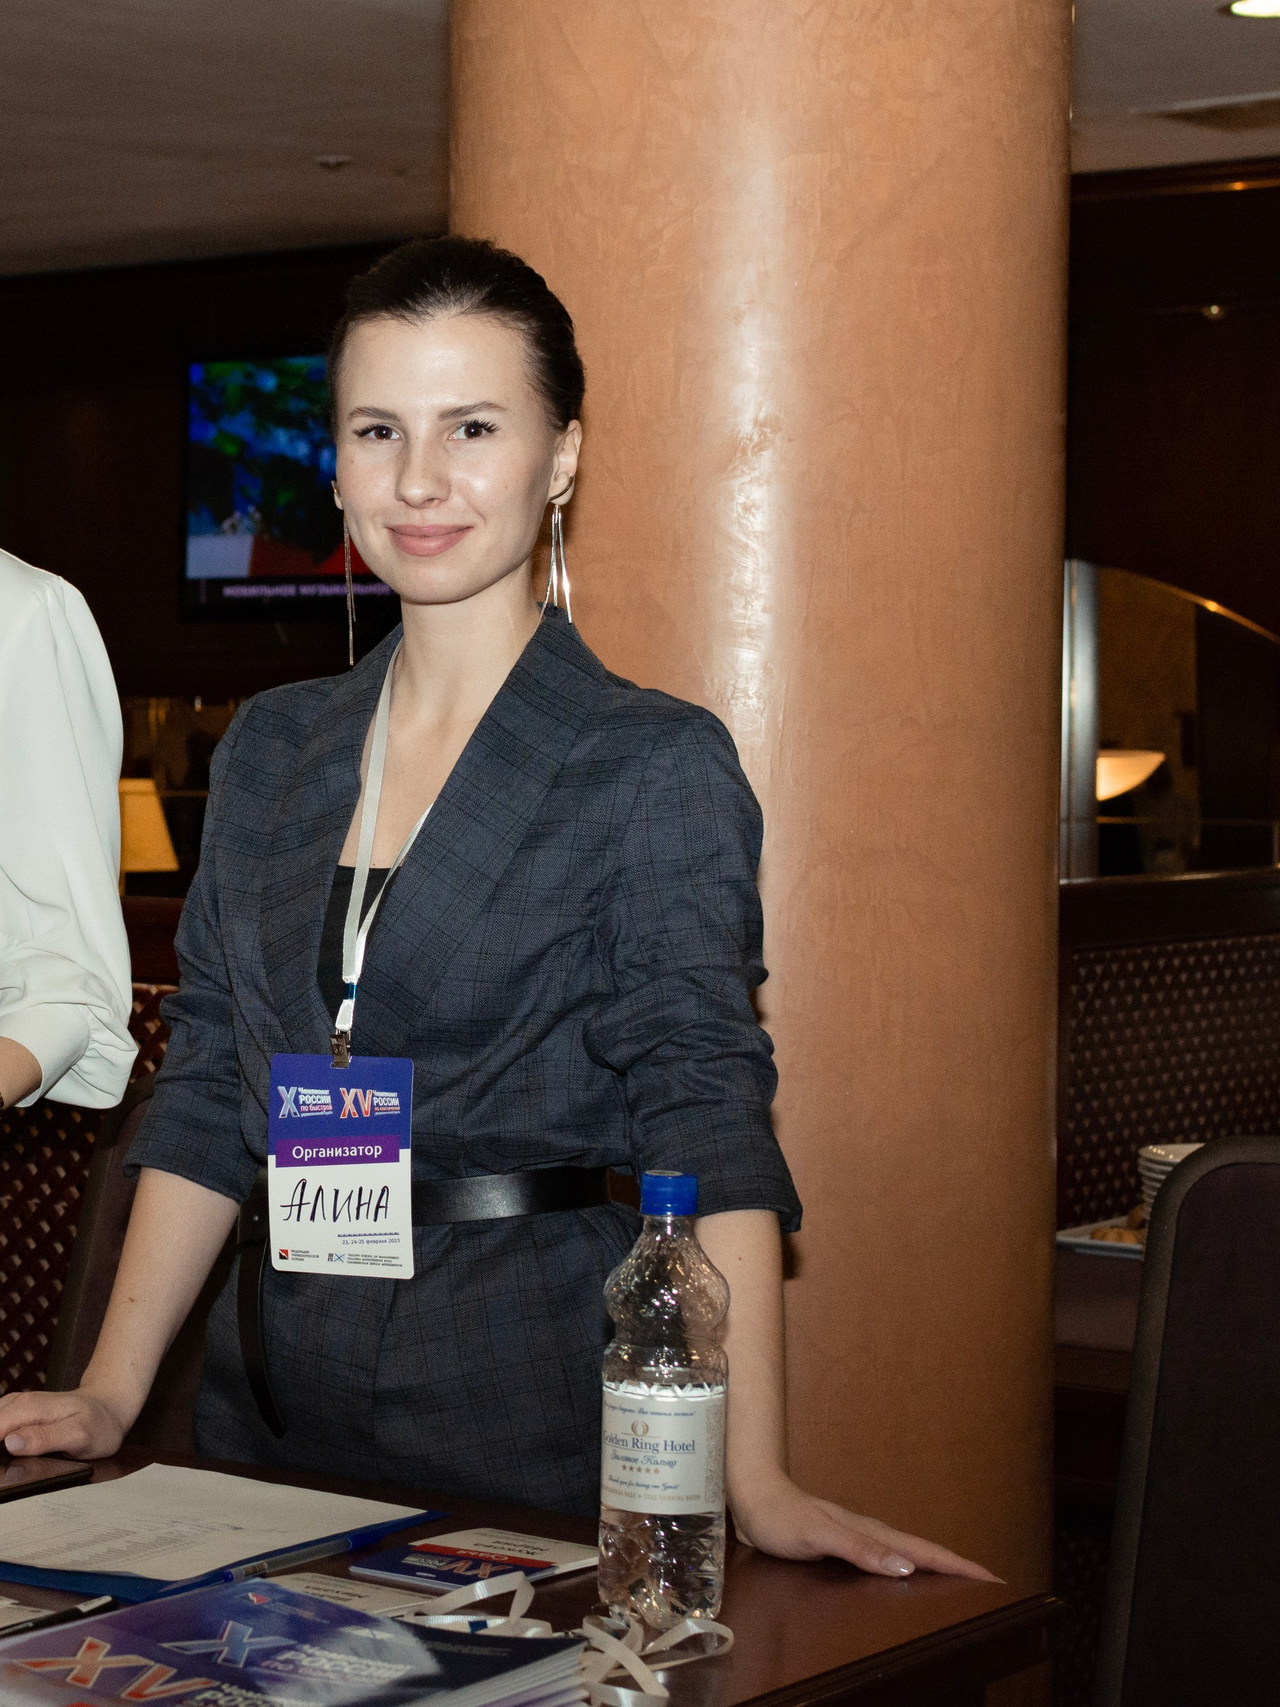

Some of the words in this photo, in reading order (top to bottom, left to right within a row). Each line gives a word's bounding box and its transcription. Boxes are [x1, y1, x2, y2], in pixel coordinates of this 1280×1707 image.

[277, 1085, 300, 1119] X
[298, 1094, 332, 1105] РОССИИ
[309, 1103, 333, 1113] быстрой
[339, 1087, 373, 1119] XV
[373, 1097, 400, 1106] РОССИИ
[292, 1145, 383, 1162] Организатор
[280, 1178, 390, 1223] АЛИНА
[365, 1238, 388, 1246] февраля
[631, 1437, 660, 1454] Ring
[663, 1440, 696, 1452] Hotel
[13, 1636, 221, 1701] XV
